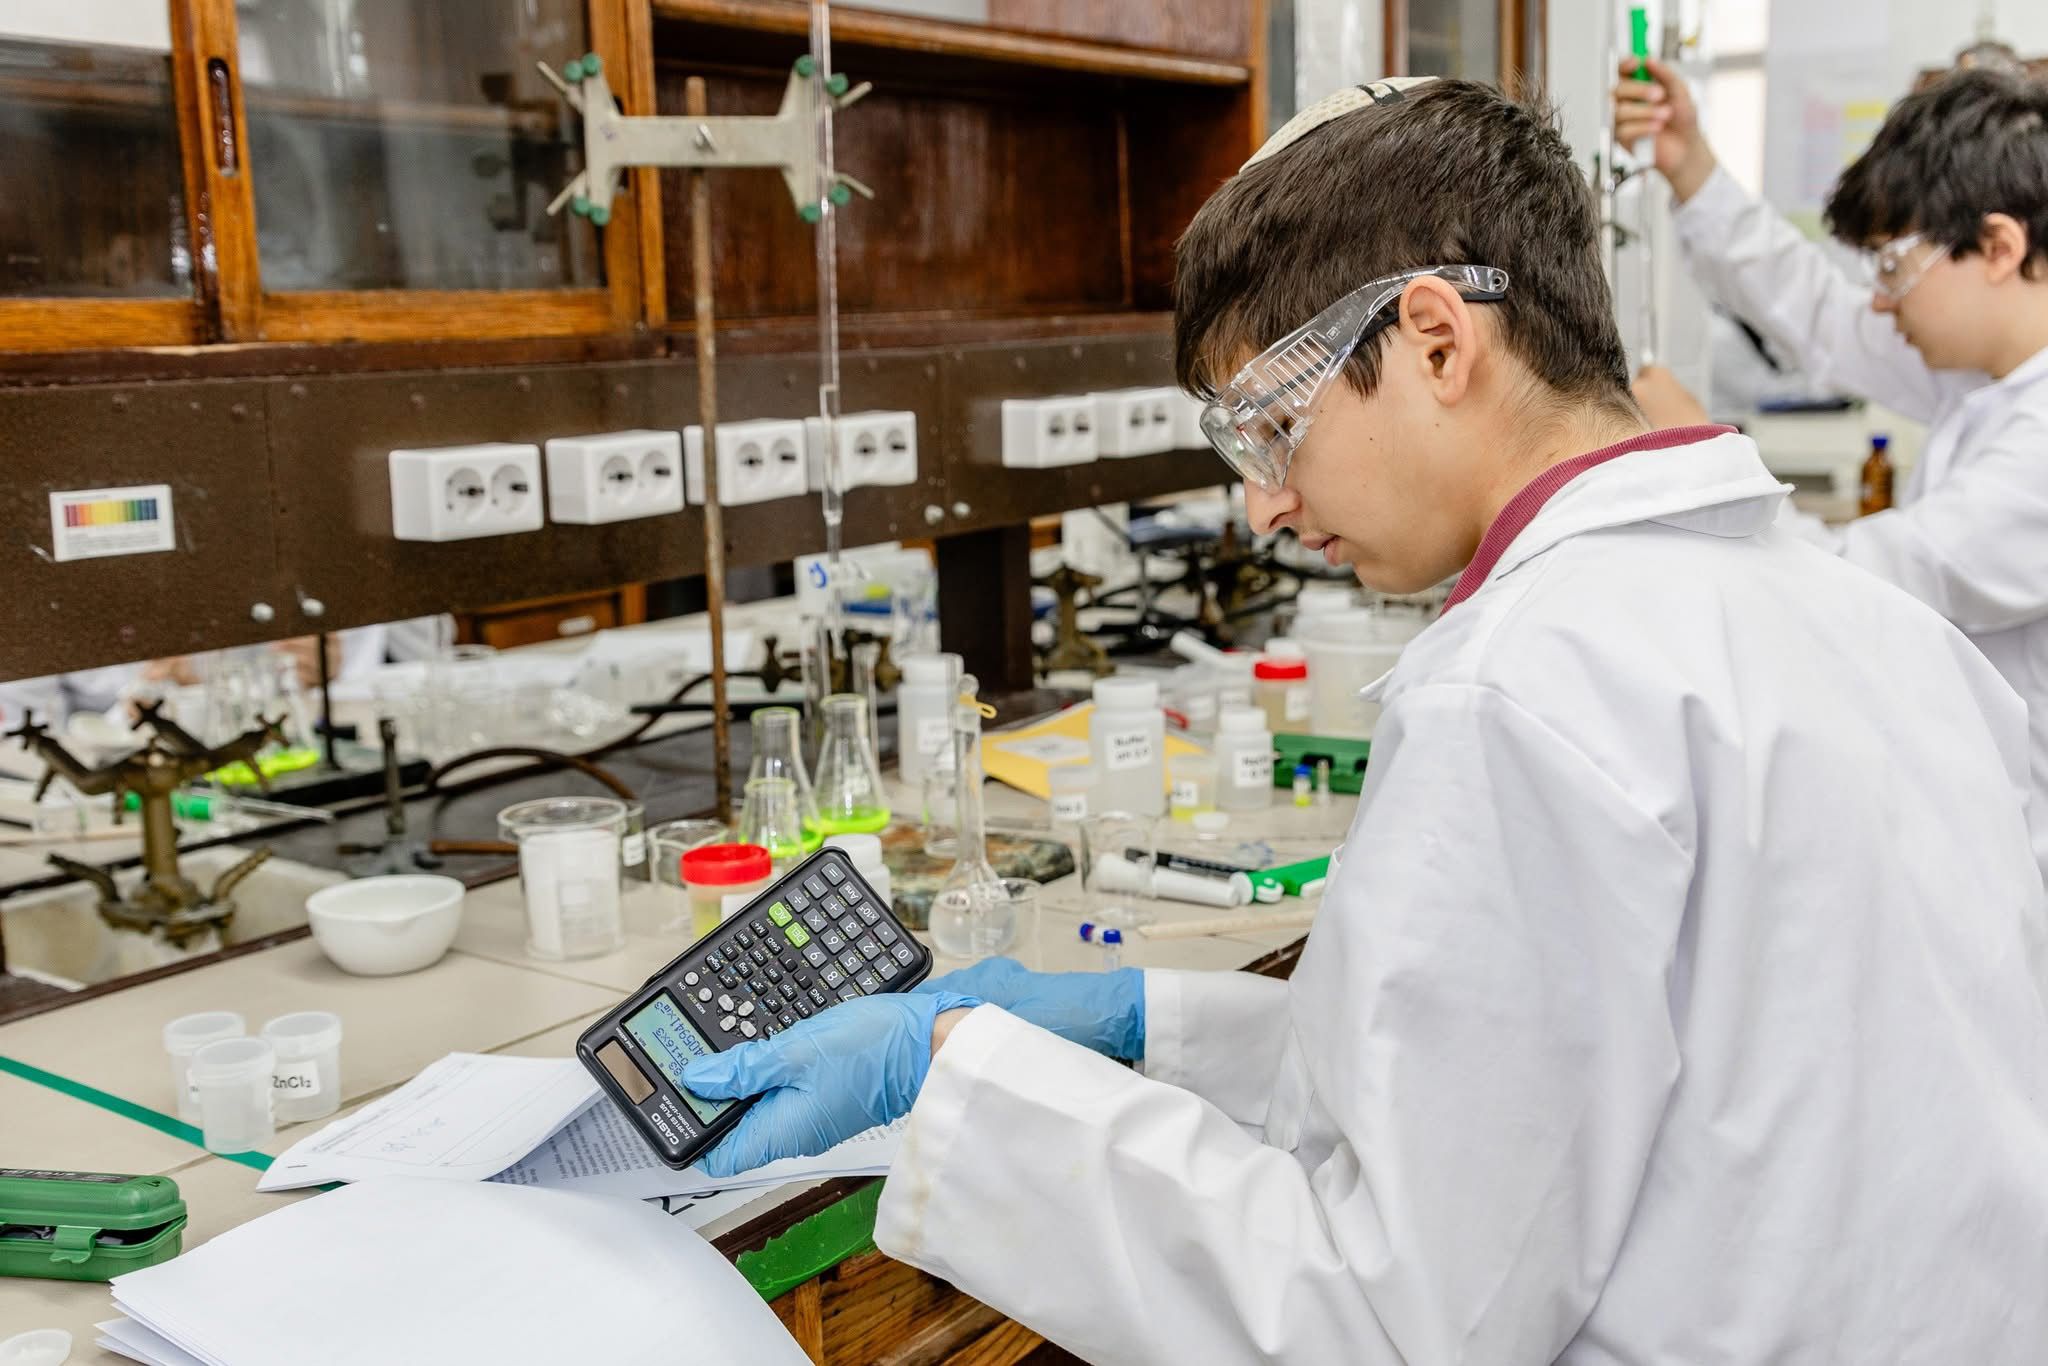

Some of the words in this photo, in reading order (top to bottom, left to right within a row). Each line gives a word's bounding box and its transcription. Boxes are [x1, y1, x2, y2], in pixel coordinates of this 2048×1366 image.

[844, 884, 858, 899] Ans
[773, 906, 788, 921] AC
[845, 921, 856, 932] 3
[739, 932, 749, 943] tan
[788, 924, 806, 943] DEL
[827, 935, 838, 944] 6
[862, 941, 874, 952] 2
[753, 950, 763, 960] cos
[809, 951, 820, 960] 9
[897, 948, 908, 959] 0
[844, 956, 856, 967] 5
[738, 961, 748, 974] log
[768, 968, 777, 977] sin
[880, 963, 890, 972] 1
[826, 970, 838, 981] 8
[861, 976, 872, 985] 4
[677, 981, 686, 990] ON
[782, 984, 793, 996] hyp
[810, 988, 824, 1004] ENG
[842, 989, 856, 1002] 7
[694, 1002, 706, 1014] MODE
[624, 1040, 634, 1049] 2nd
[658, 1102, 672, 1118] PLUS
[651, 1112, 679, 1145] CASIO
